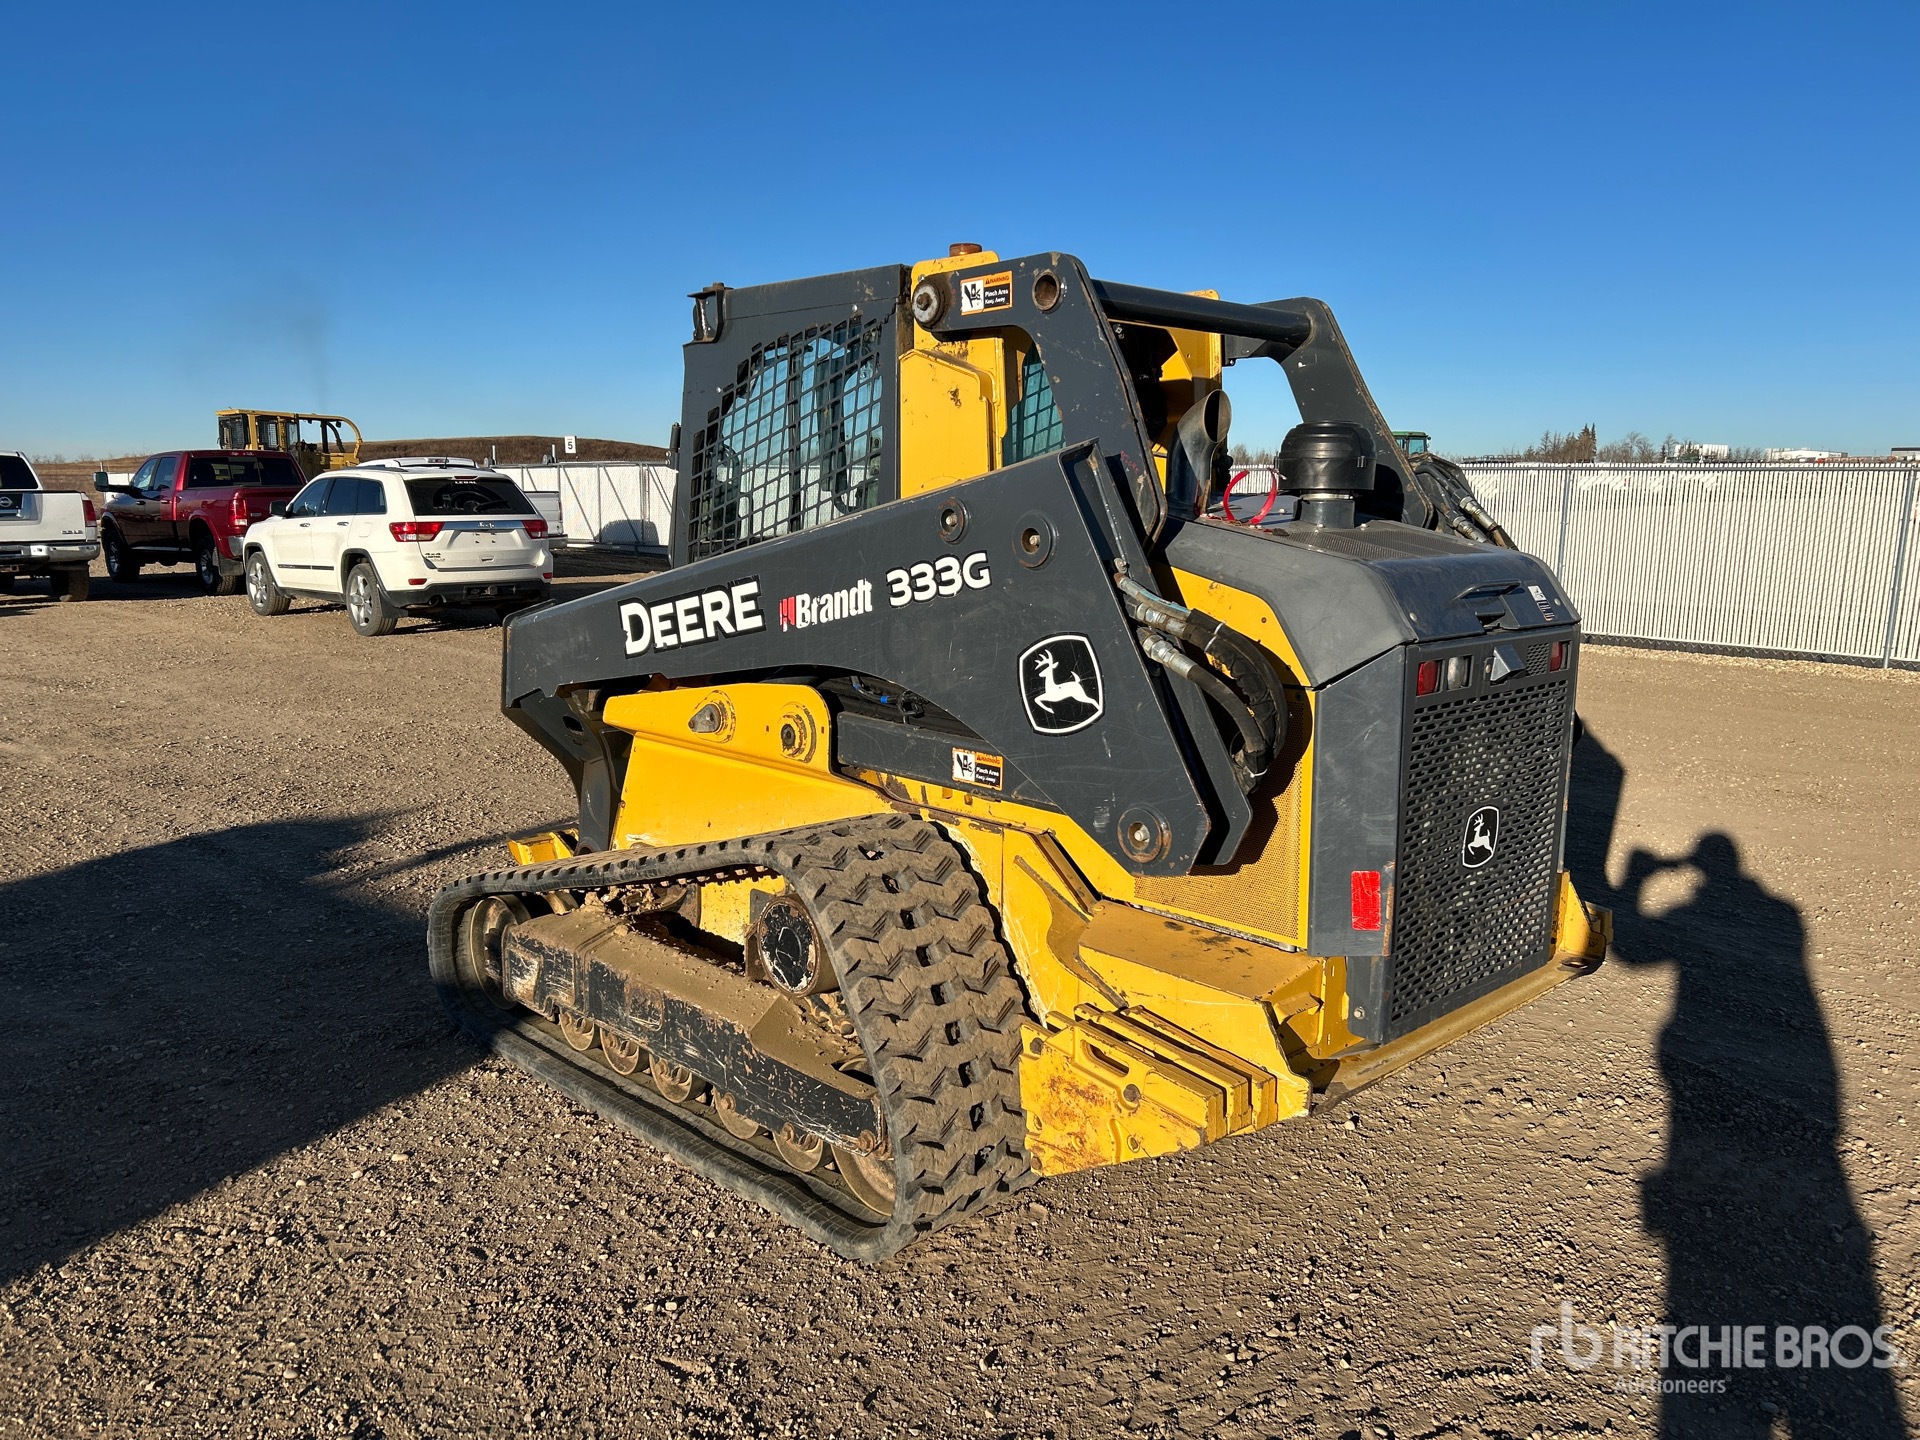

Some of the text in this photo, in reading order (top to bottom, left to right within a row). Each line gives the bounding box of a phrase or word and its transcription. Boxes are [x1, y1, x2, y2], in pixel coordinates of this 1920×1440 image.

[988, 275, 1010, 284] WARNING
[567, 441, 573, 450] 5
[619, 551, 992, 655] DEERE Brandt 333G
